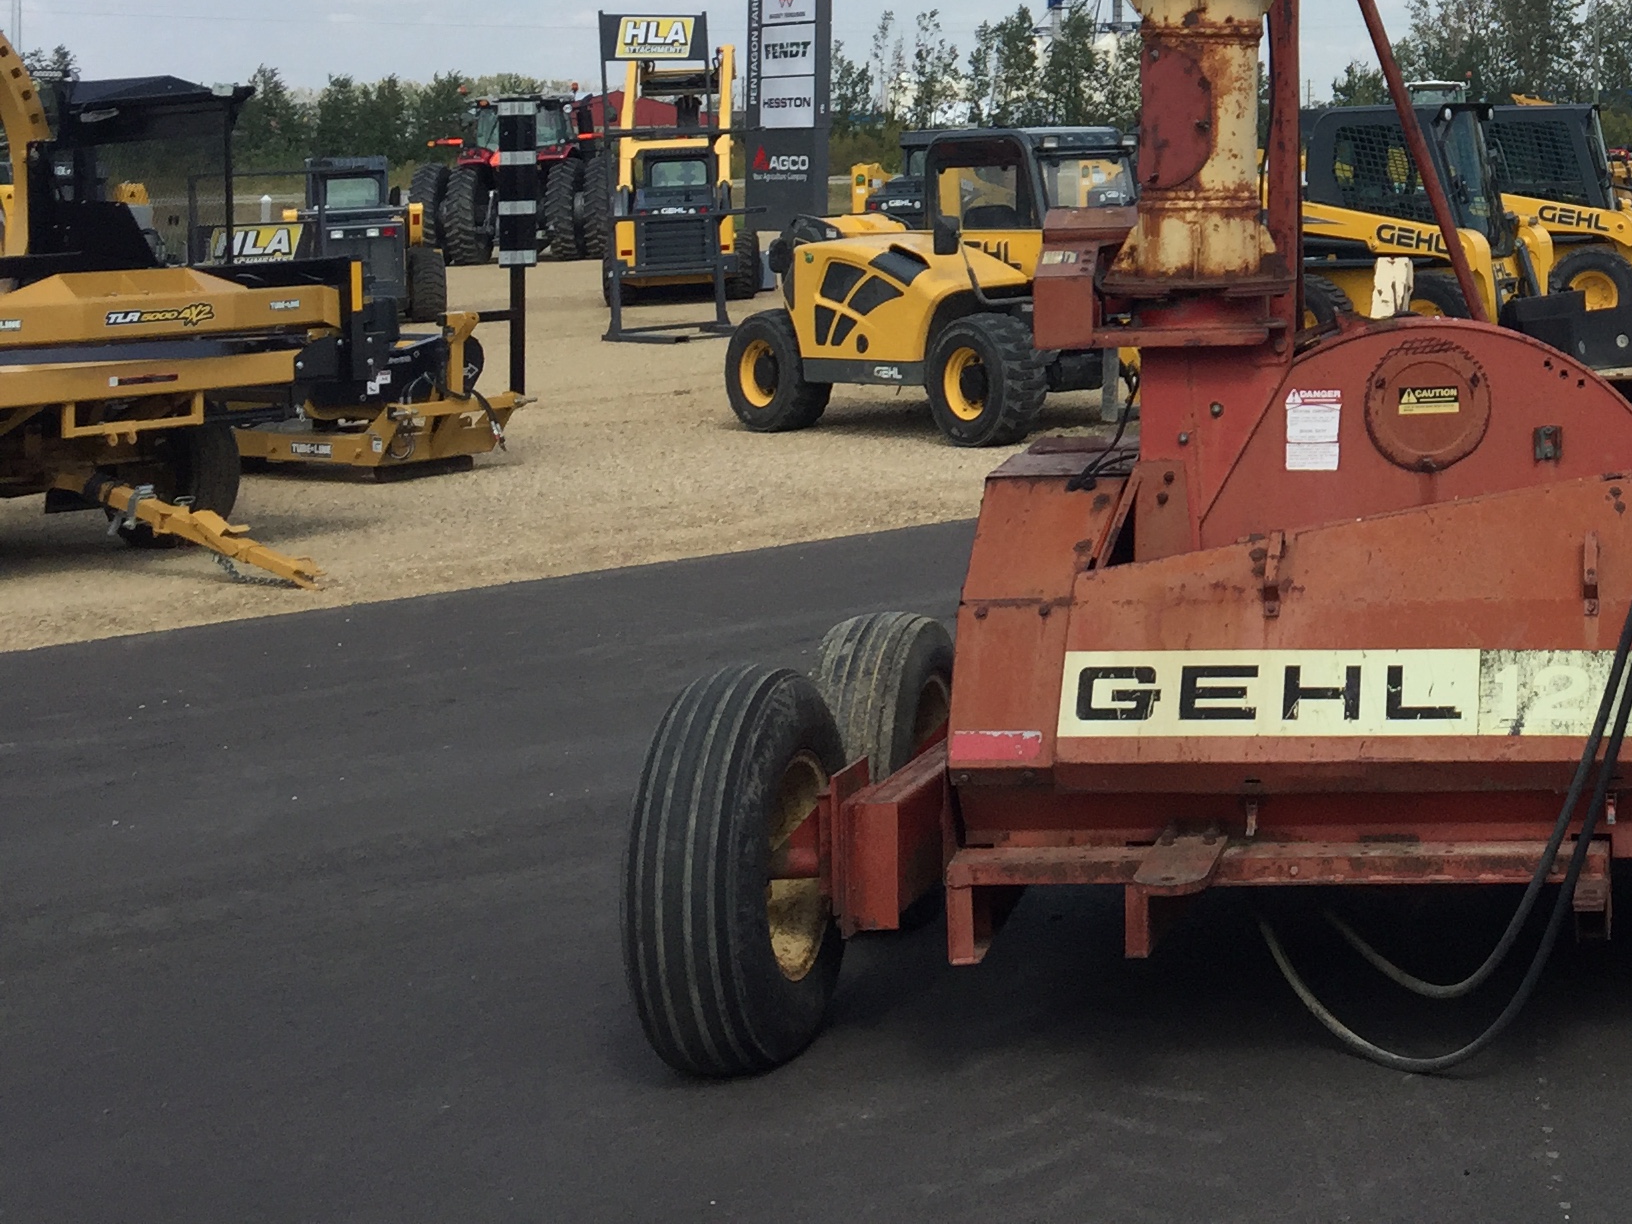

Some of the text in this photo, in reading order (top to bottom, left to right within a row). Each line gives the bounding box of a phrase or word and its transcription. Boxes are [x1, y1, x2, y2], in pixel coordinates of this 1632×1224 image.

[624, 22, 688, 45] HLA
[764, 41, 811, 59] FENDT
[750, 31, 759, 105] PENTAGON
[763, 97, 811, 108] HESSTON
[769, 156, 809, 170] AGCO
[1539, 205, 1610, 232] GEHL
[1376, 224, 1449, 252] GEHL
[108, 312, 141, 324] TLR
[141, 311, 178, 322] 5000
[873, 366, 903, 379] GEHL
[1300, 390, 1341, 398] DANGER
[1415, 388, 1457, 397] CAUTION
[1076, 664, 1463, 721] GEHL
